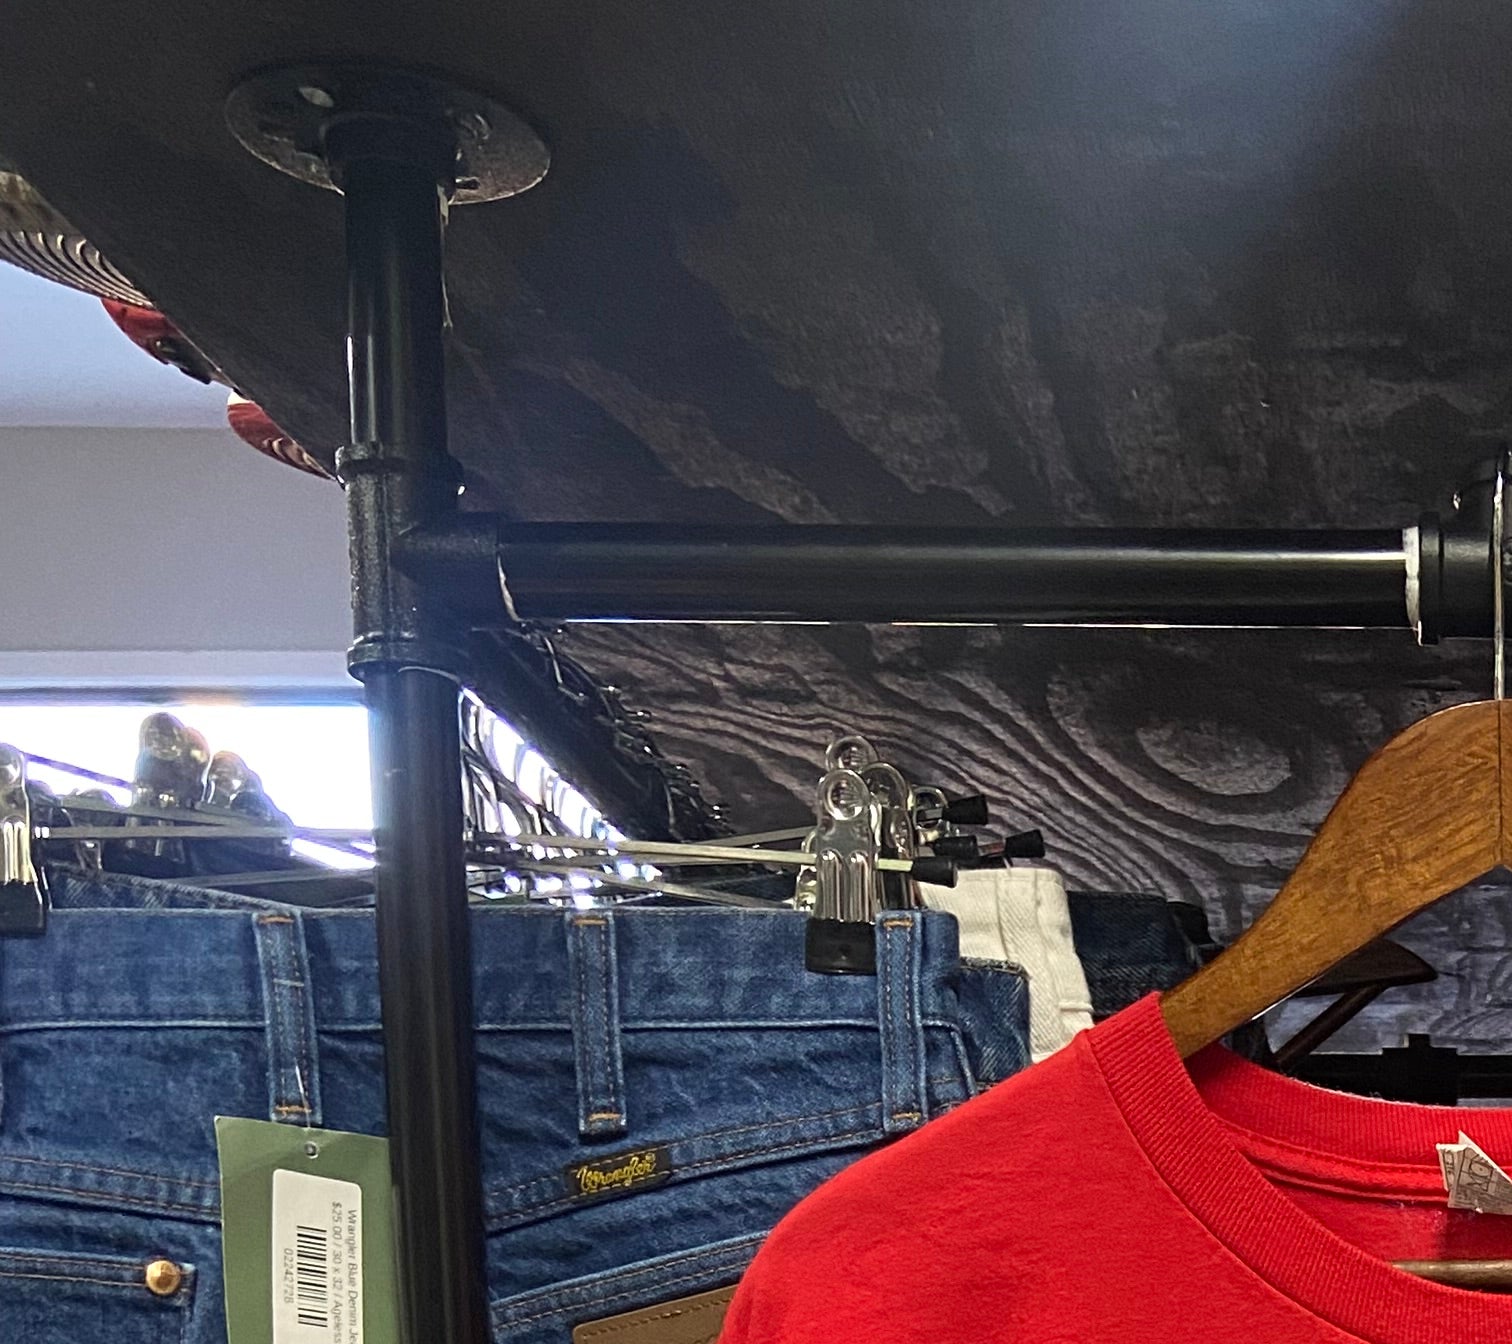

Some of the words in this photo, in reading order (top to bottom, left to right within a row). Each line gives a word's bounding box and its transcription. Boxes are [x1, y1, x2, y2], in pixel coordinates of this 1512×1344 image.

[576, 1153, 656, 1194] Wrangler
[346, 1209, 358, 1259] Wrangler
[332, 1250, 342, 1265] 30
[348, 1263, 358, 1288] Blue
[331, 1300, 344, 1344] Ageless
[348, 1290, 358, 1327] Denim
